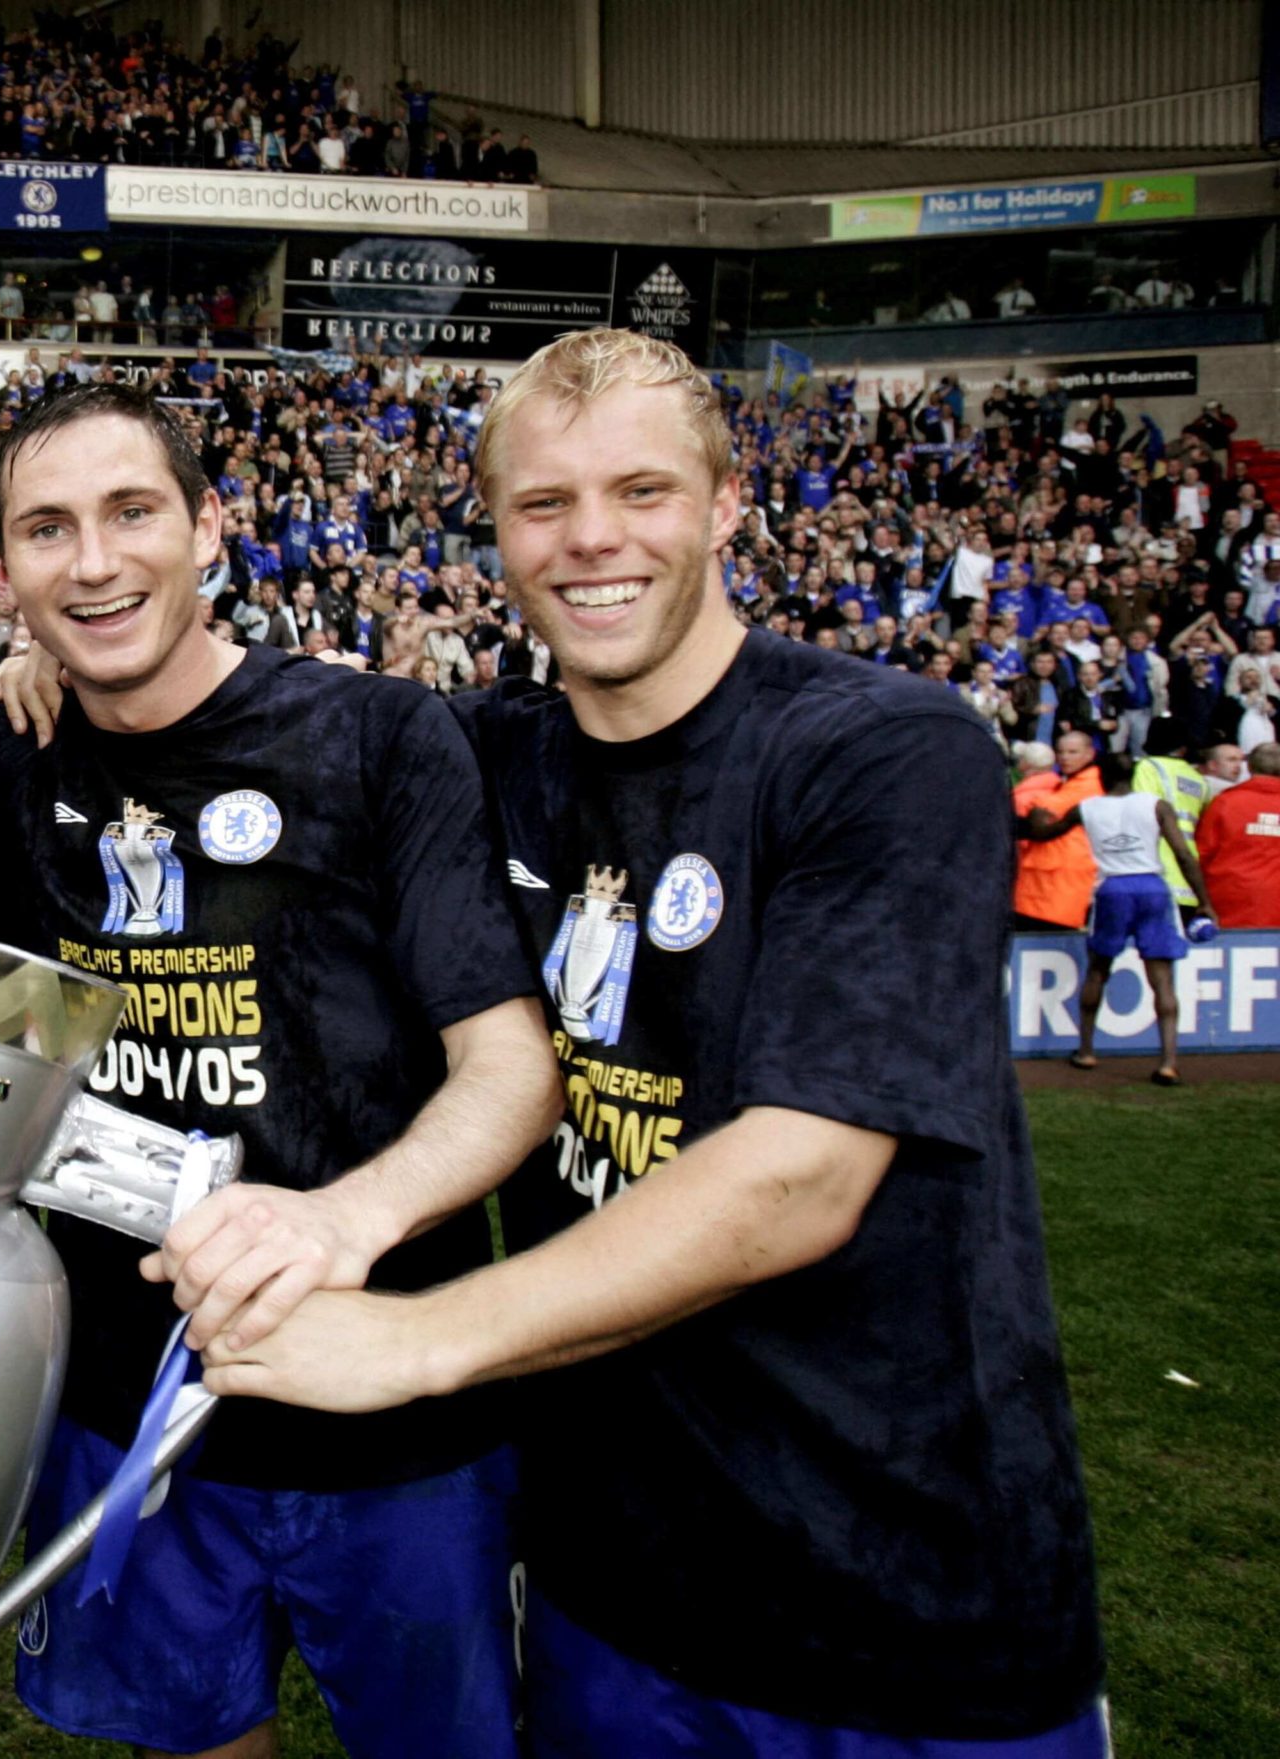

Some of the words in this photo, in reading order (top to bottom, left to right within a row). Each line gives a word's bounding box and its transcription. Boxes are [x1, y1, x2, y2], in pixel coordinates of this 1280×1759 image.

[973, 191, 1003, 211] for
[1006, 186, 1097, 210] Holidays
[16, 213, 62, 229] 1905
[311, 257, 497, 285] REFLECTIONS
[488, 301, 551, 314] restaurant
[564, 303, 601, 315] whites
[631, 307, 691, 326] WHITES
[1107, 369, 1195, 386] Endurance.
[664, 858, 708, 878] CHELSEA
[59, 937, 123, 974] BARCLAYS
[130, 944, 256, 976] PREMIERSHIP
